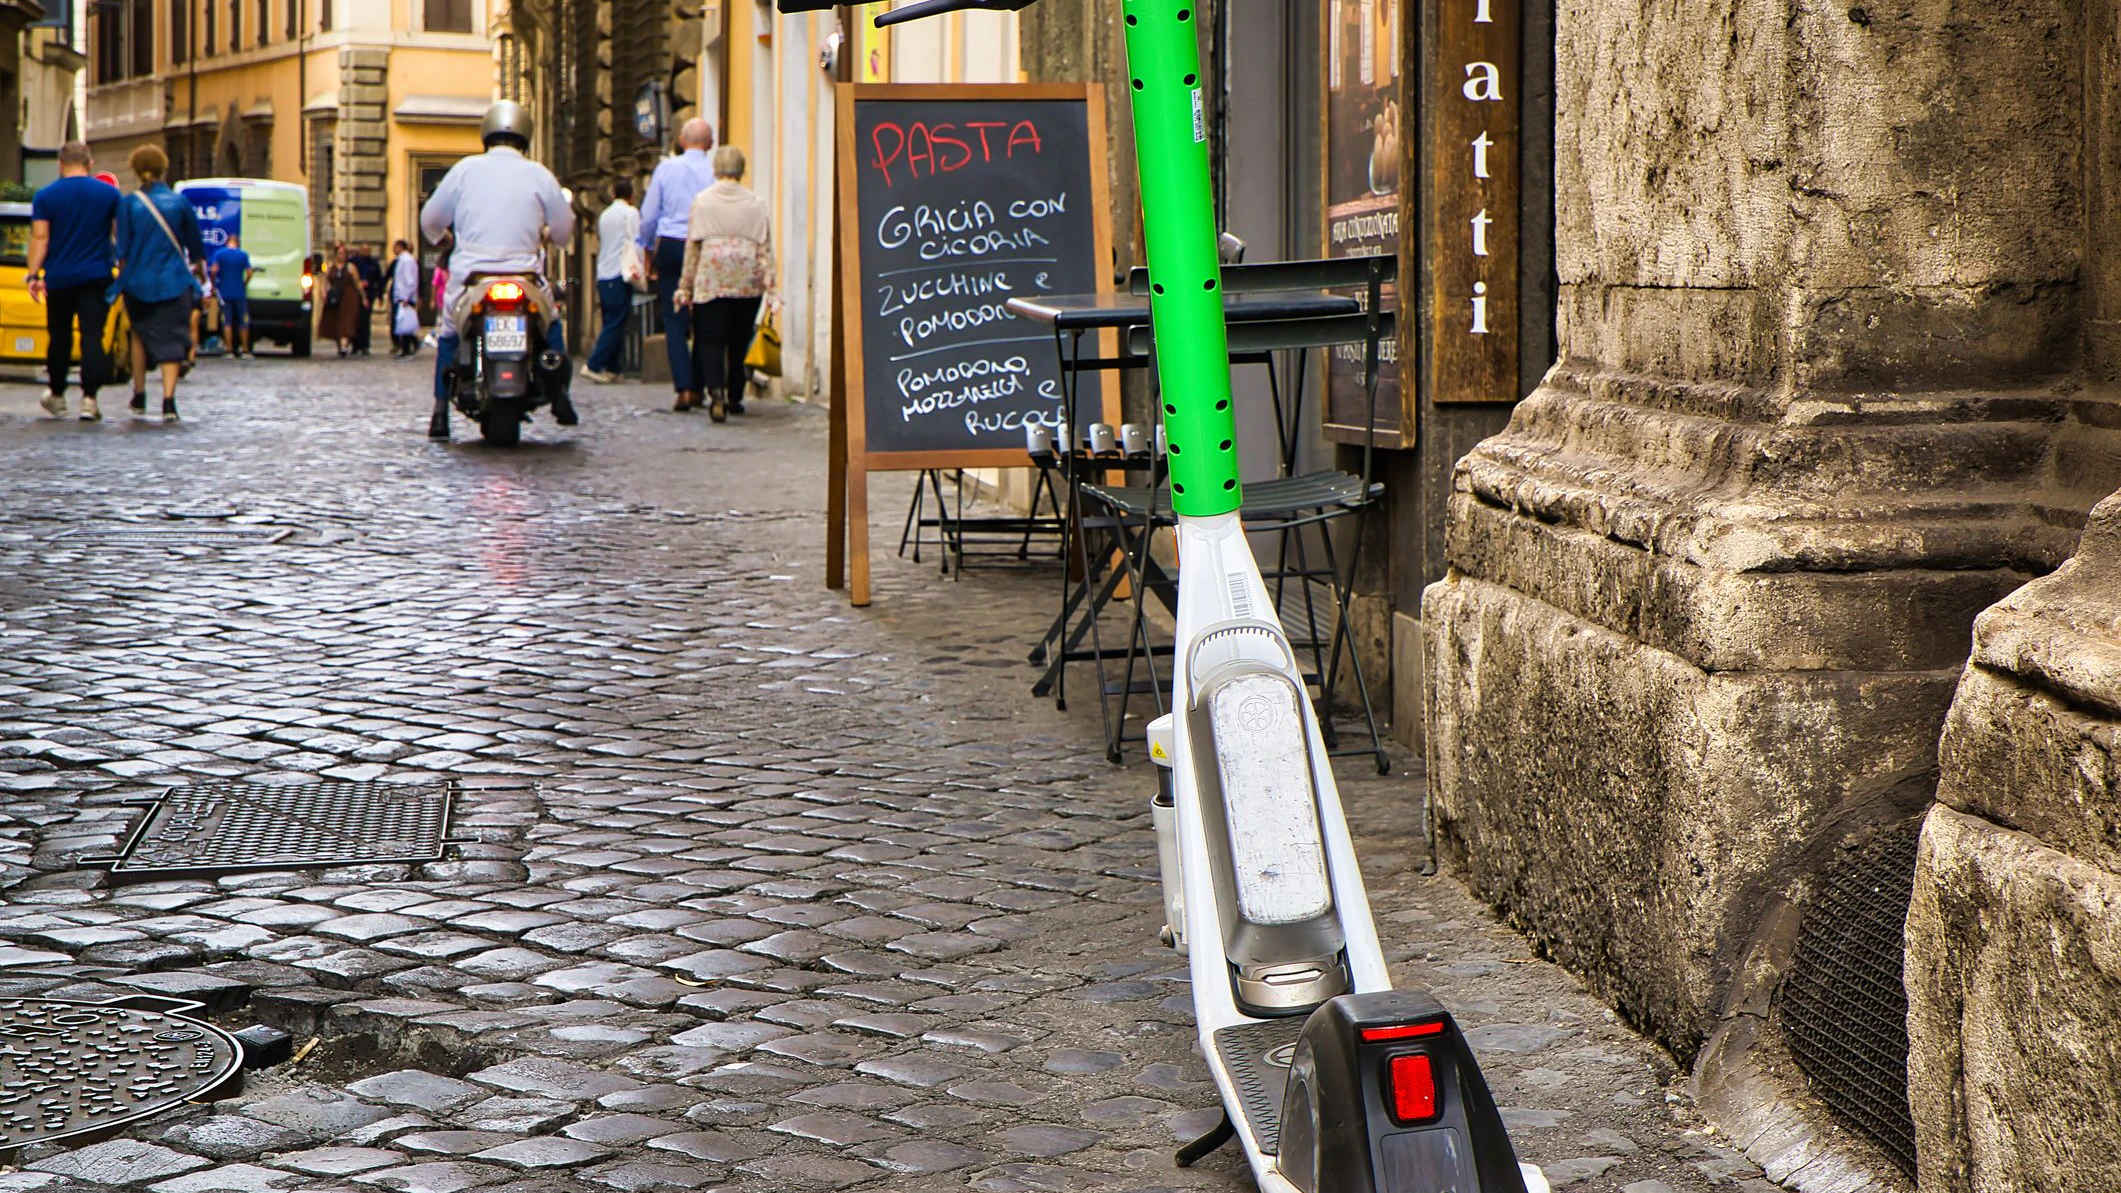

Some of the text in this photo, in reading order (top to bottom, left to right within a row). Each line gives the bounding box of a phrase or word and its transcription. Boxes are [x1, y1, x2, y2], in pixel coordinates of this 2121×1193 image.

[872, 120, 1042, 188] PASTA
[878, 192, 1067, 248] GRICIA CON
